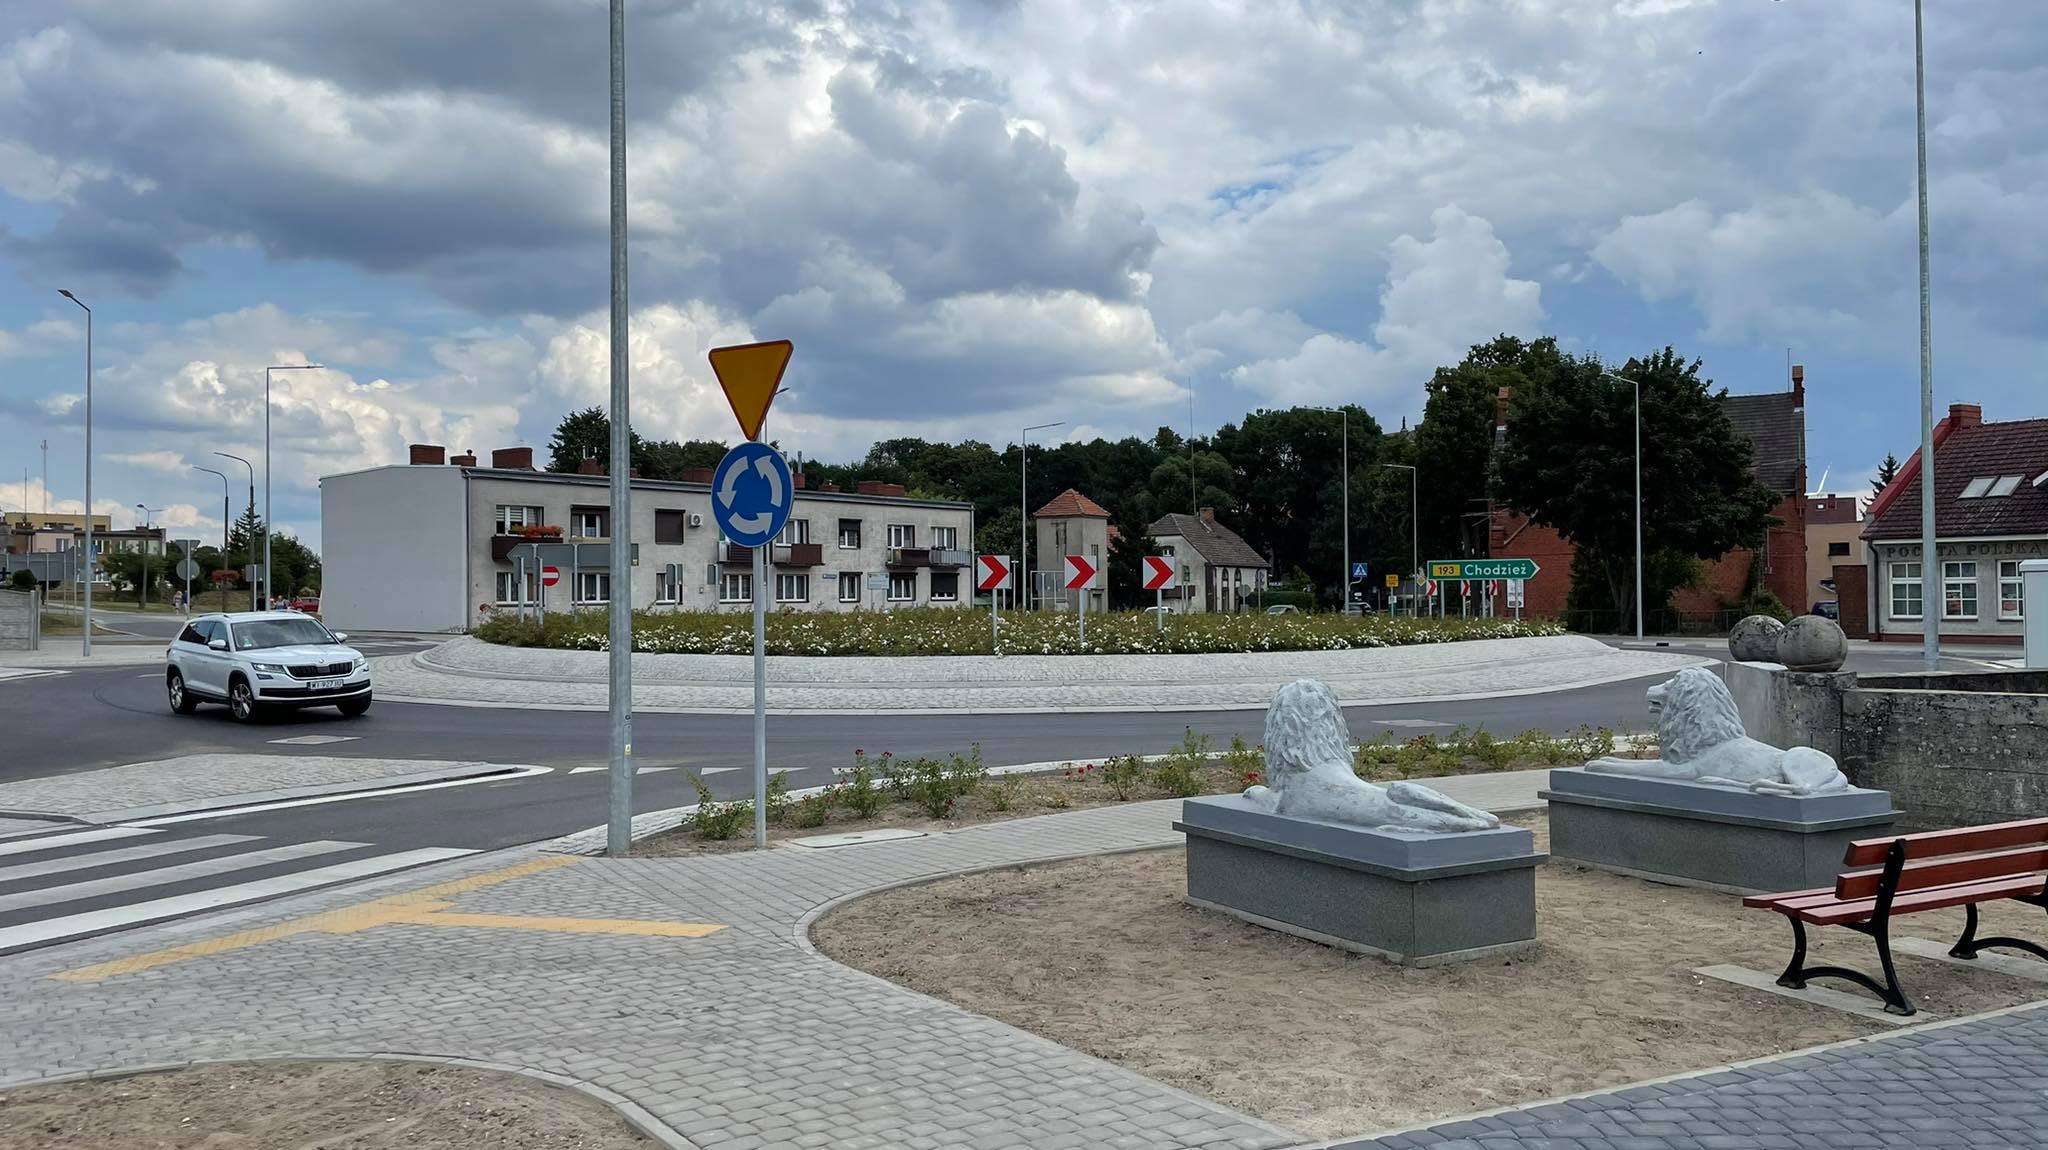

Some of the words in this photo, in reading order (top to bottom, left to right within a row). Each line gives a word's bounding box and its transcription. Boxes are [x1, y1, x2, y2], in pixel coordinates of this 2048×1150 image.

[1887, 545, 1958, 558] POCTA
[1966, 542, 2042, 556] POLSKA
[1438, 566, 1455, 575] 193
[1464, 563, 1527, 576] Chodzież
